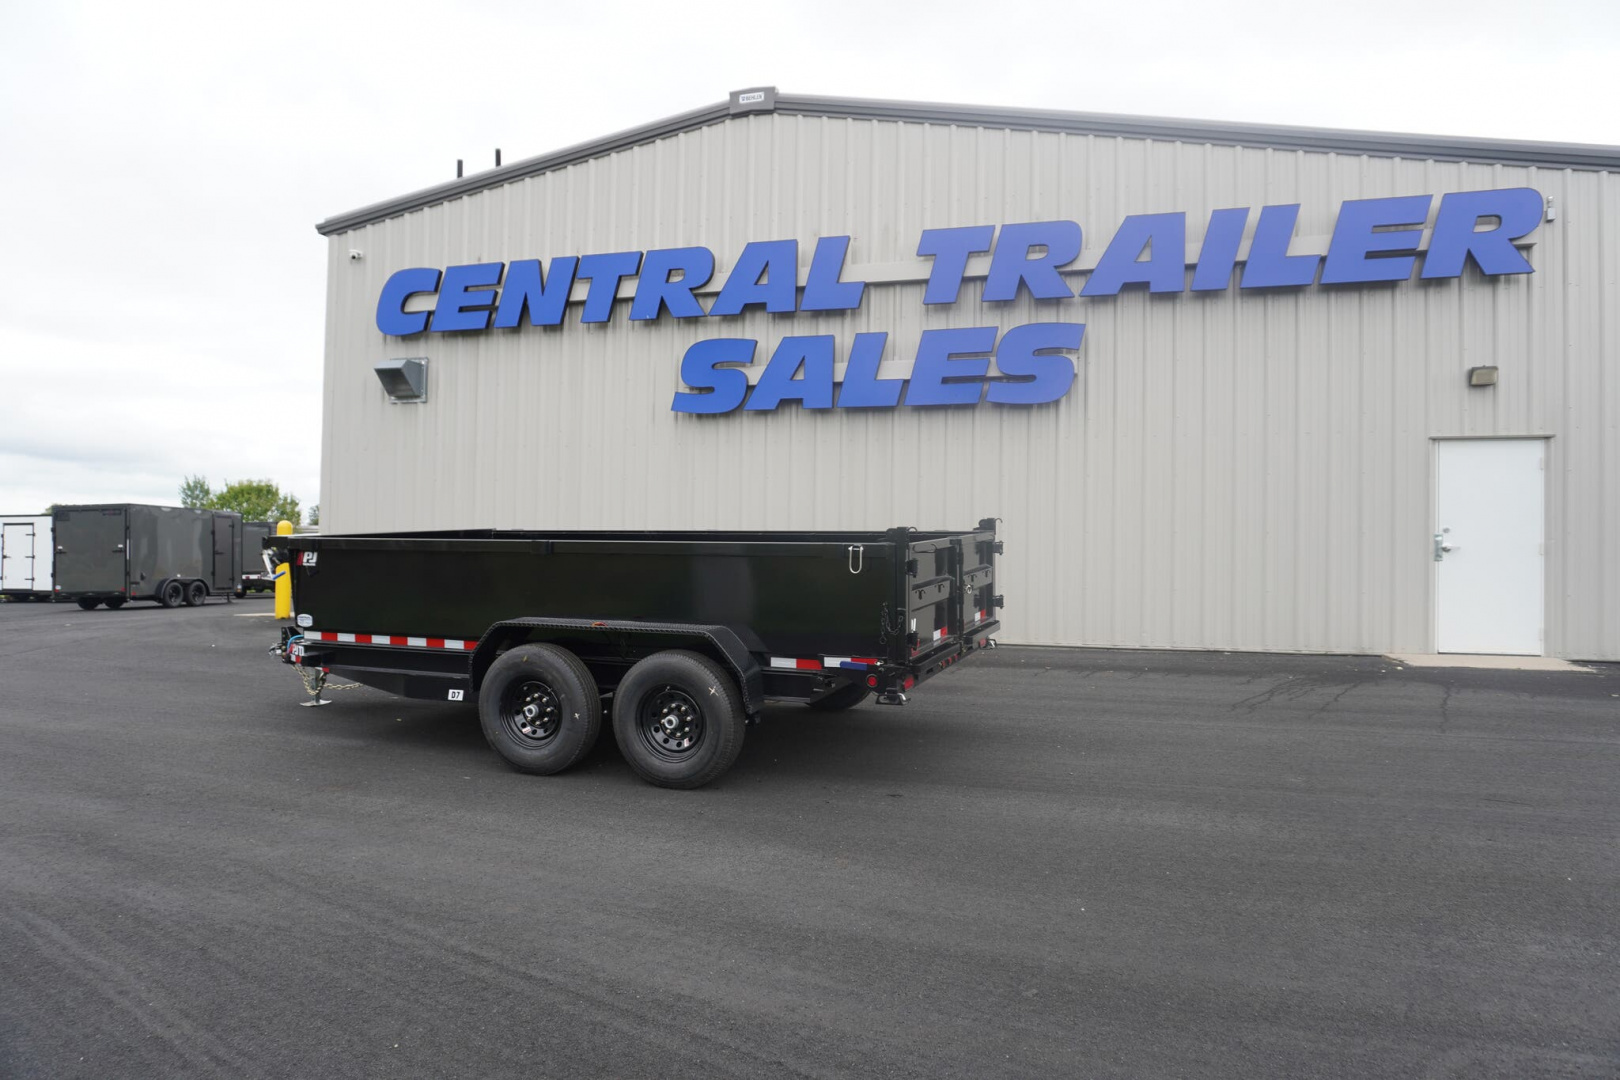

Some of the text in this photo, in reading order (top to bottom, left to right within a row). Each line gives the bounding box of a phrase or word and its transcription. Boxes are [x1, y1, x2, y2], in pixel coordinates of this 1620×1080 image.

[376, 188, 1544, 337] CENTRAL TRAILER
[671, 322, 1086, 415] SALES
[303, 551, 317, 563] PJ
[451, 691, 461, 699] D7
